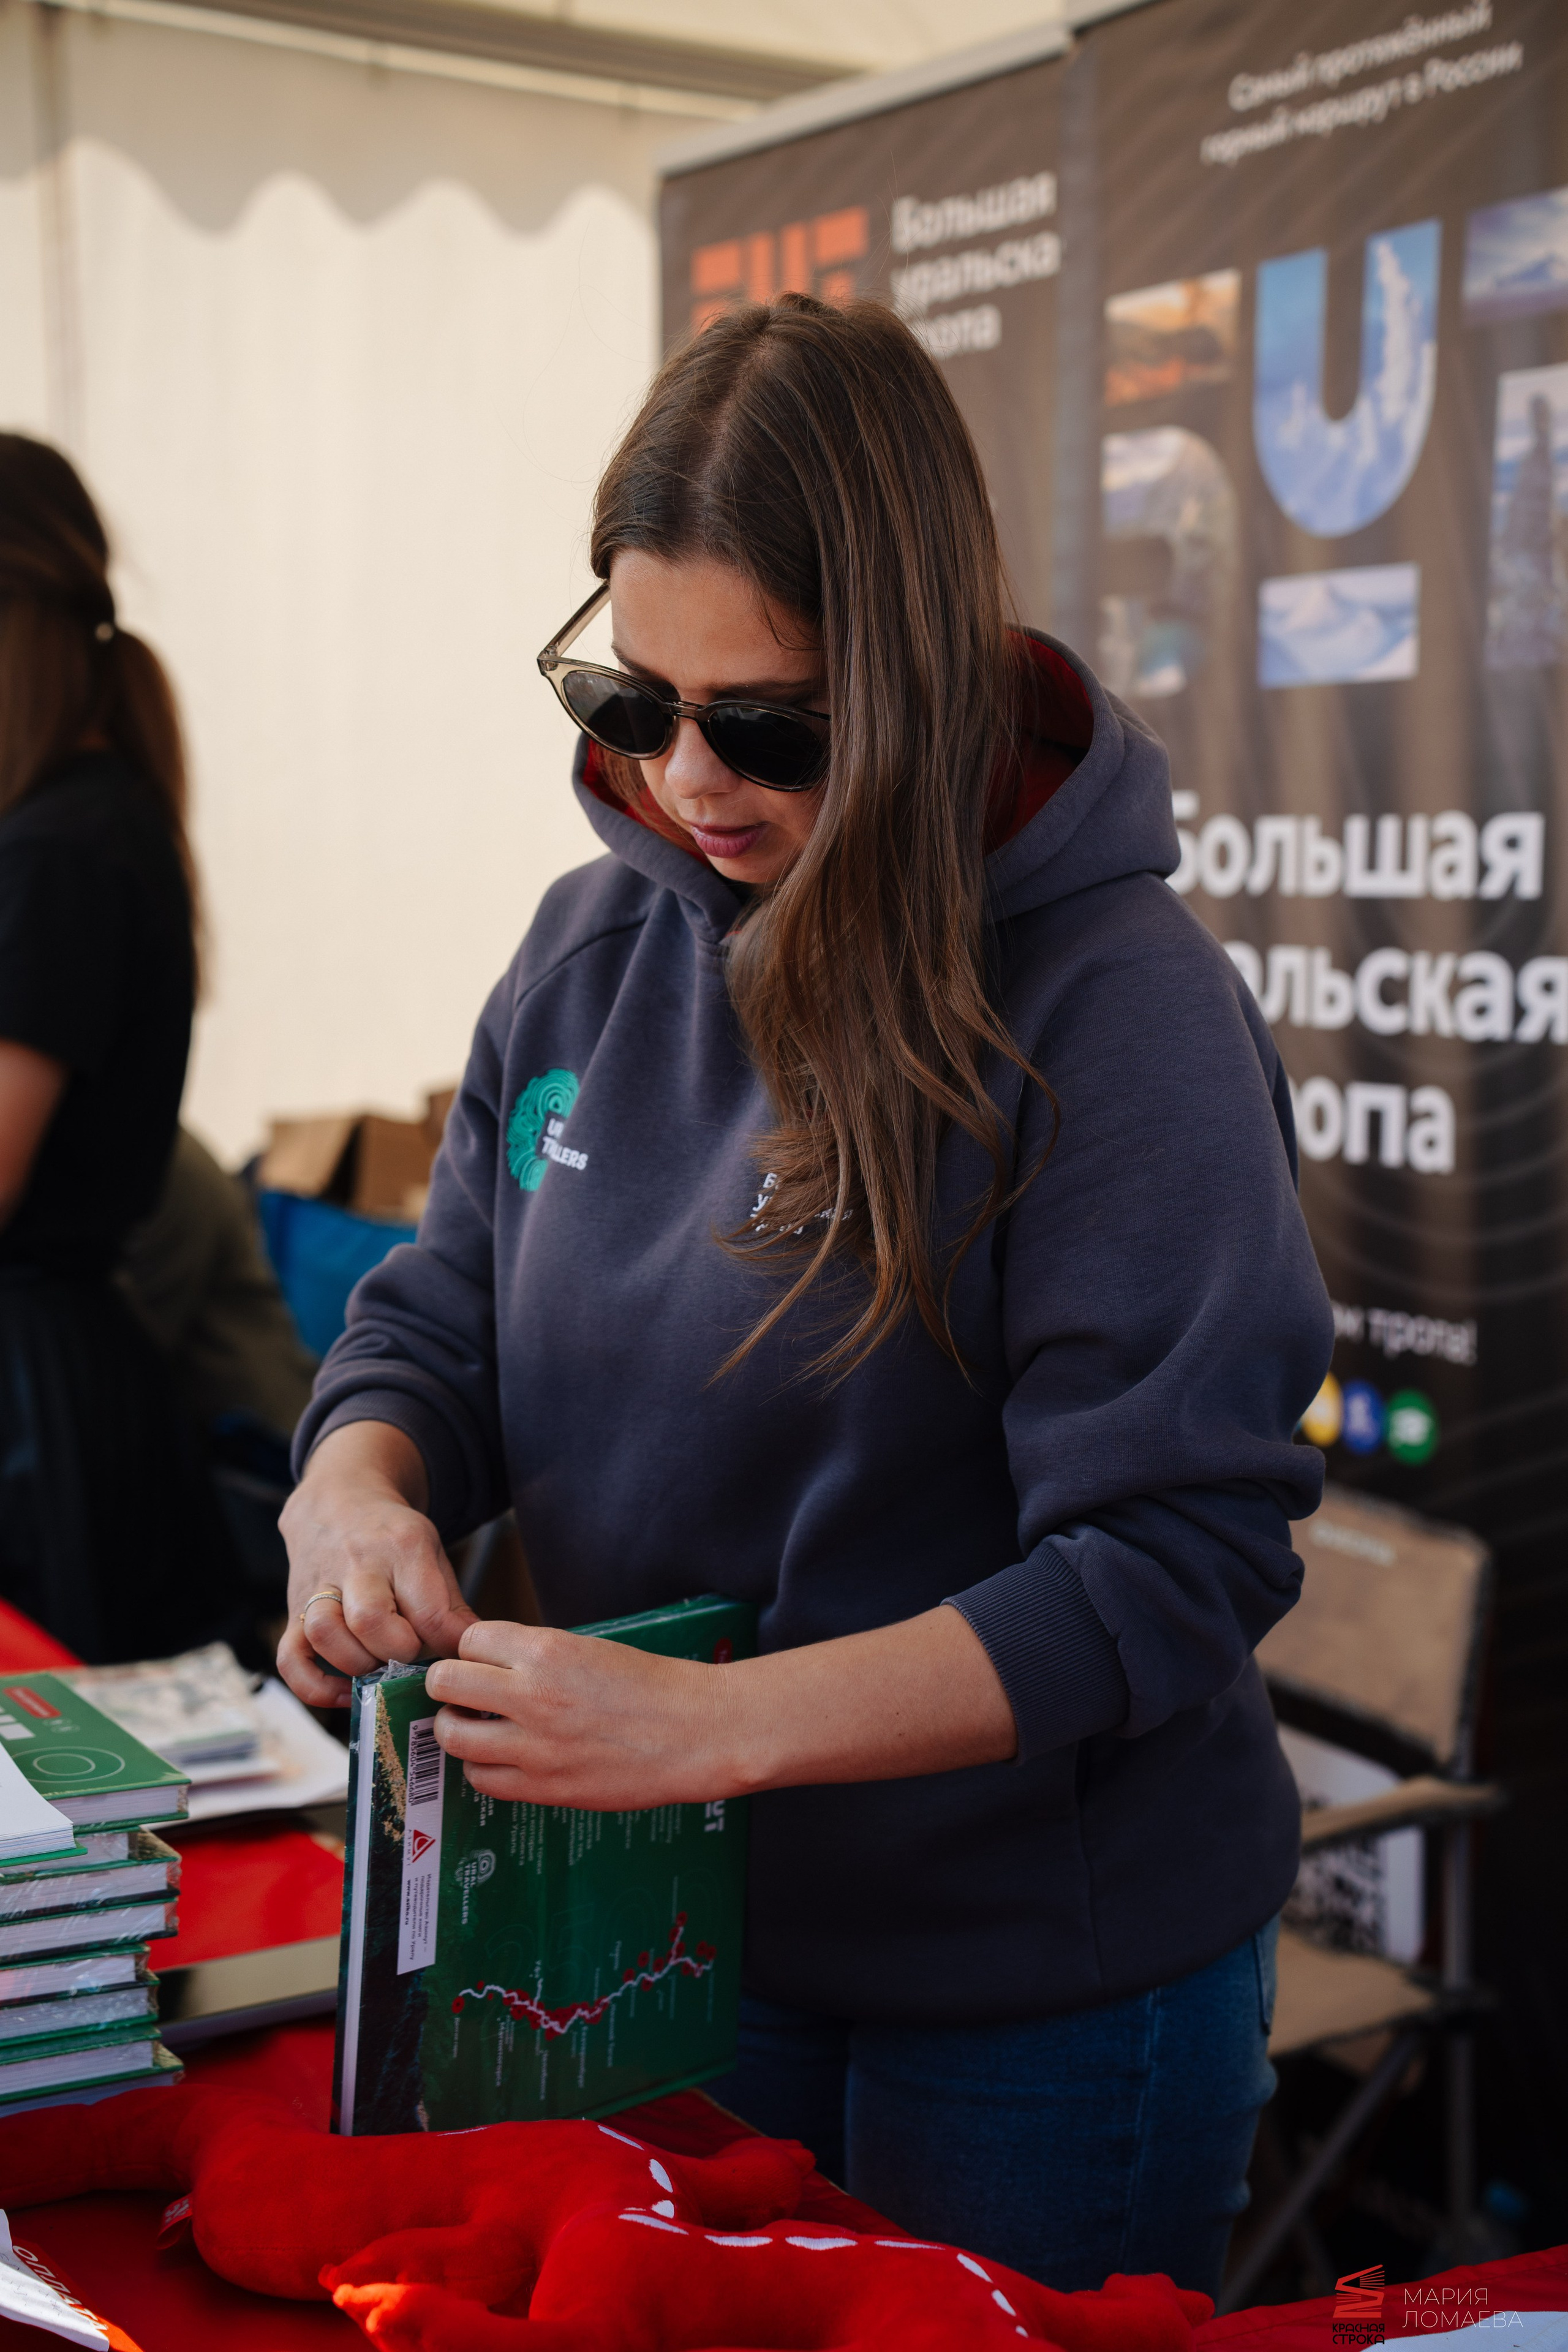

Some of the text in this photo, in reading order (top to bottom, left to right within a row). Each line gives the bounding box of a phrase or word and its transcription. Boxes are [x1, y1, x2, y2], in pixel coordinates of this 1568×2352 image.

[891, 170, 1058, 255] Большая
[1290, 1074, 1457, 1176] опа
[461, 1863, 471, 1924] TRAVELLERS
